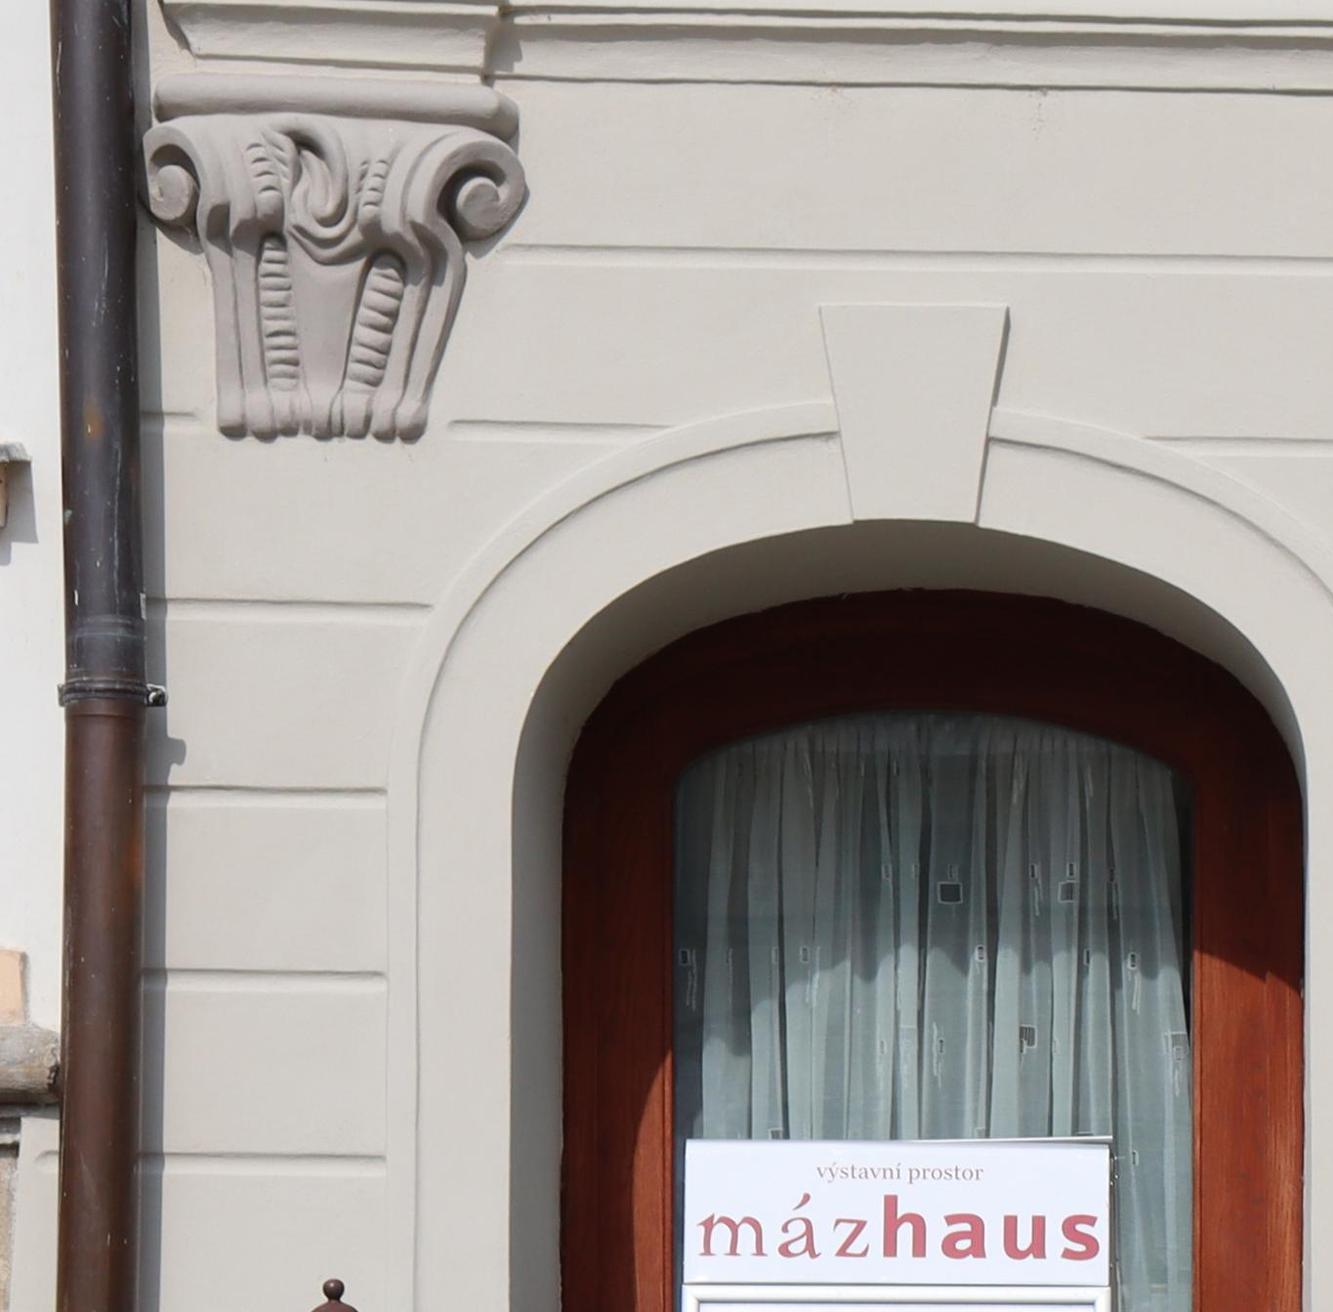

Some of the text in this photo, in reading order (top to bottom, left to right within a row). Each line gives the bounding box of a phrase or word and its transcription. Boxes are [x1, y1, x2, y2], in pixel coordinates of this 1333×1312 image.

[816, 1162, 984, 1184] výstavní prostor
[697, 1192, 1100, 1261] mázhaus
